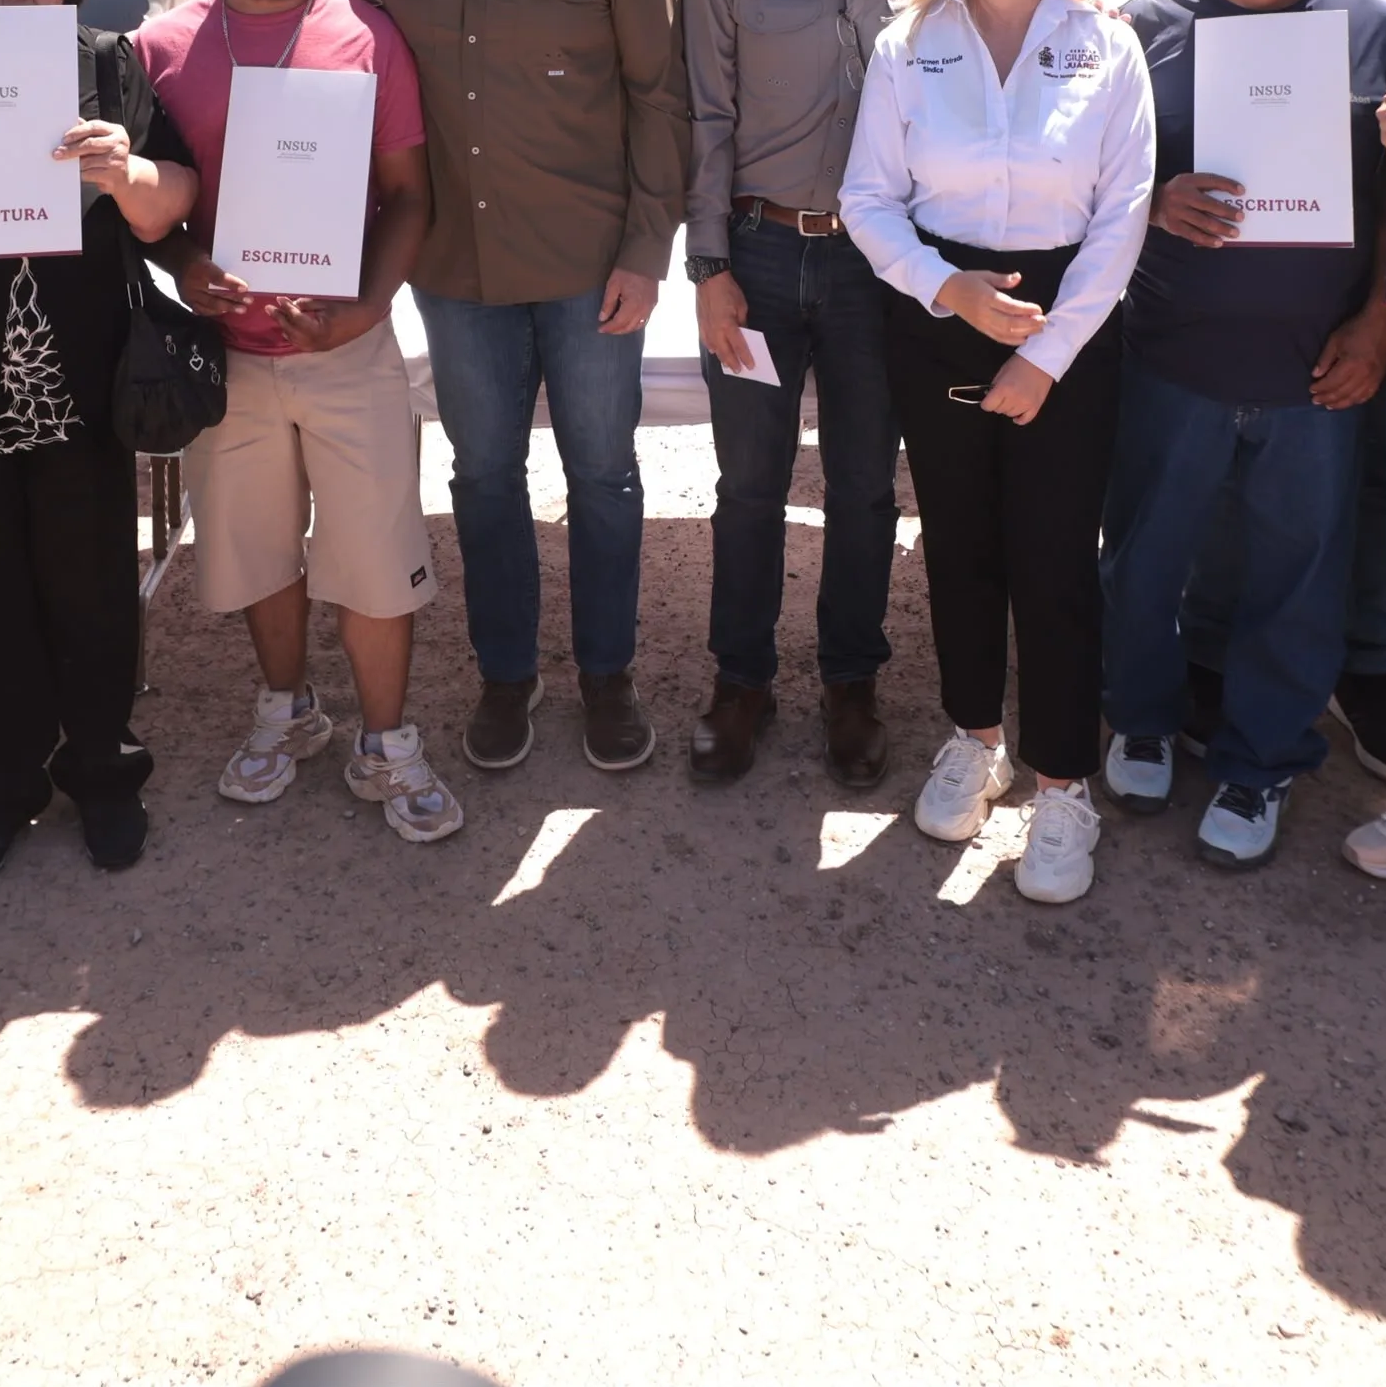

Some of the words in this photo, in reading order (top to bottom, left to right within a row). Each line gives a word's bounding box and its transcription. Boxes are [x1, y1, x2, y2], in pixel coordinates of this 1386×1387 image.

[1064, 53, 1101, 63] CIUDAD
[1249, 85, 1292, 97] INSUS
[277, 139, 318, 152] INSUS
[241, 249, 332, 266] ESCRITURA
